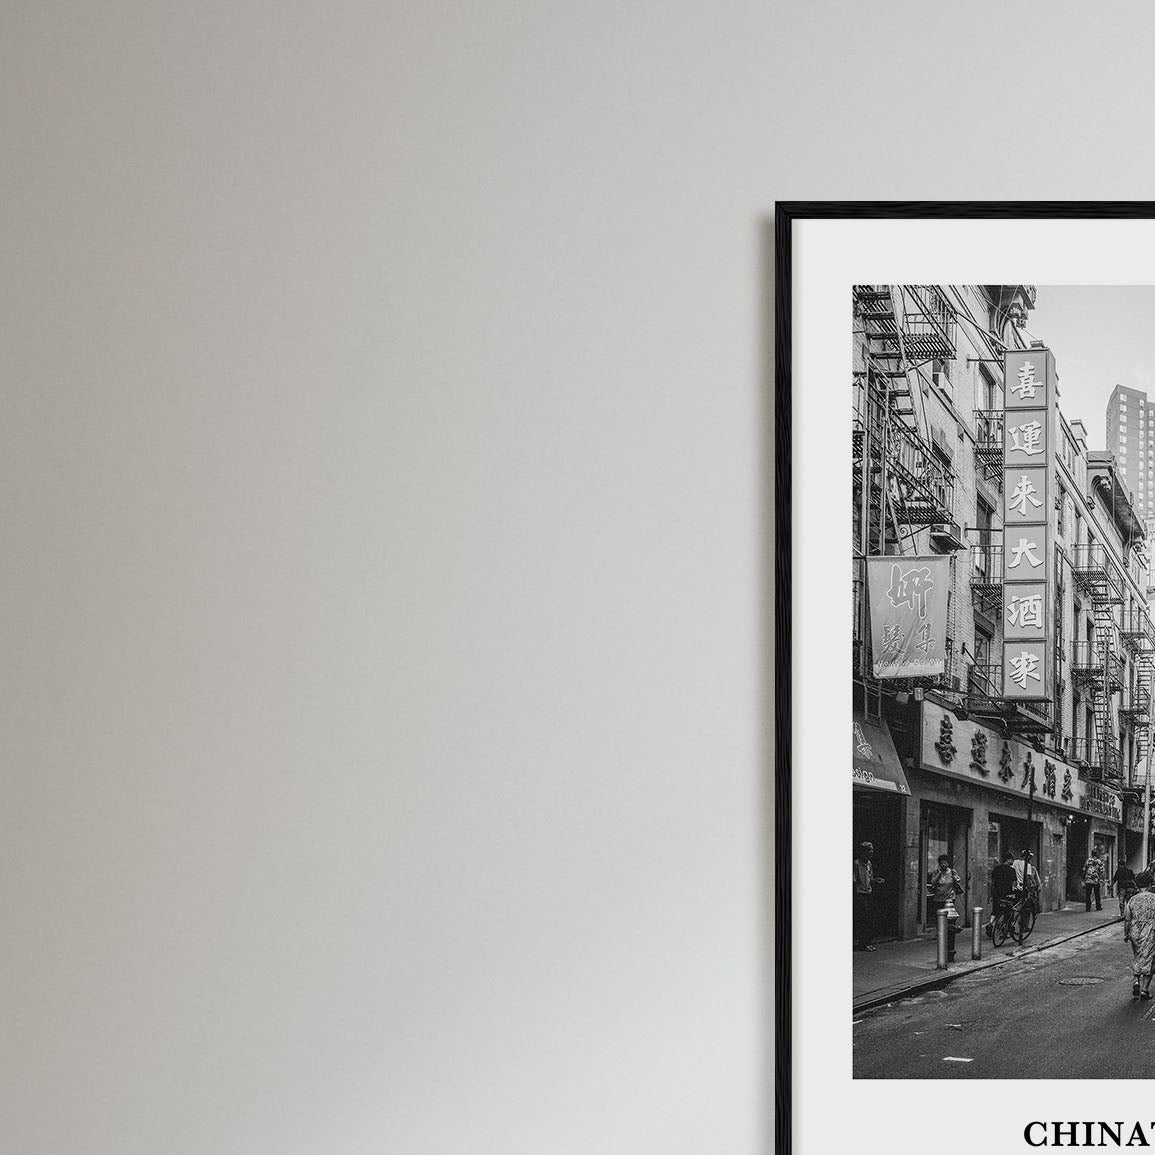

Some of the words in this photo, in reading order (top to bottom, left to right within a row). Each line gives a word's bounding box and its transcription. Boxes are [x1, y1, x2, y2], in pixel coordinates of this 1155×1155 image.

[1008, 361, 1044, 690] 喜運來大酒家
